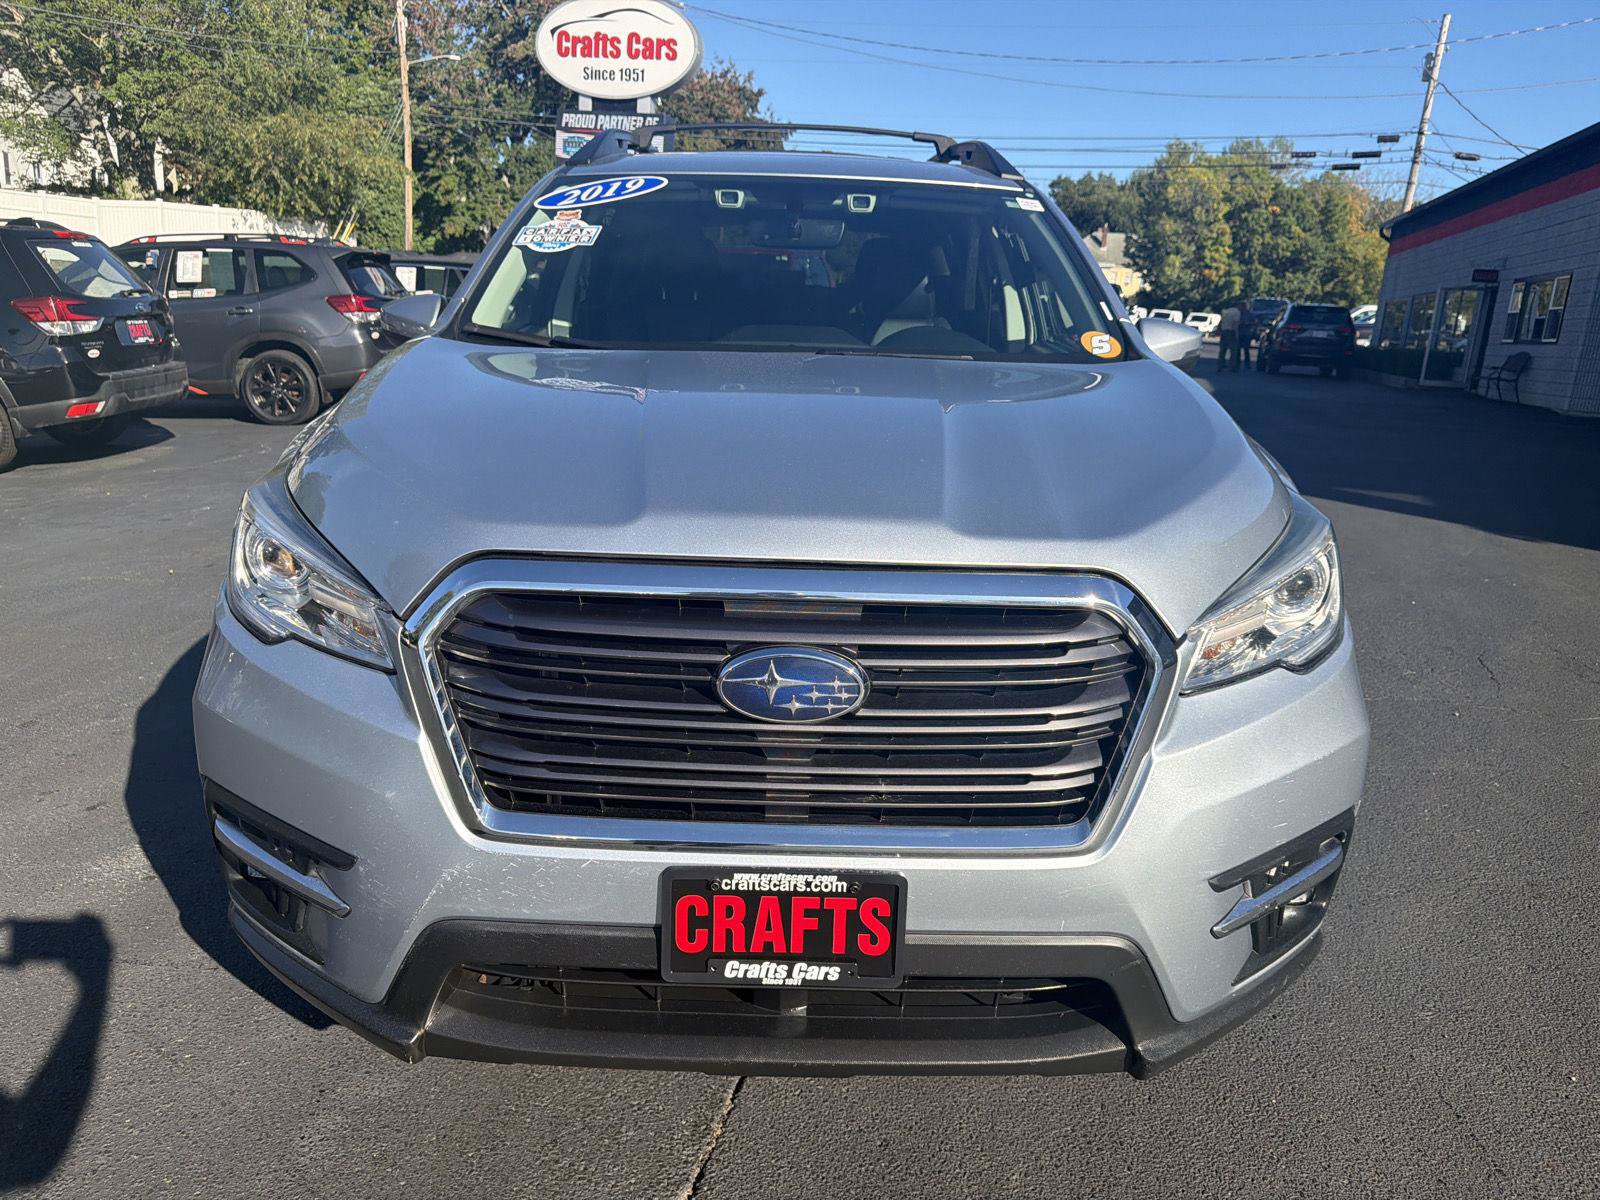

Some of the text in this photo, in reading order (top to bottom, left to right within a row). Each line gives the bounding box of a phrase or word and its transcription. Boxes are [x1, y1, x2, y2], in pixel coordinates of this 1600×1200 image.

[556, 30, 678, 61] Crafts Cars
[583, 67, 645, 82] Since 1951
[561, 113, 596, 129] PROUD
[597, 114, 643, 131] PARTNER
[556, 179, 645, 206] 2019
[721, 878, 848, 892] craftscars.com
[733, 873, 838, 882] www.craftscars.com
[675, 894, 891, 957] CRAFTS
[724, 960, 841, 981] Crafts Cars
